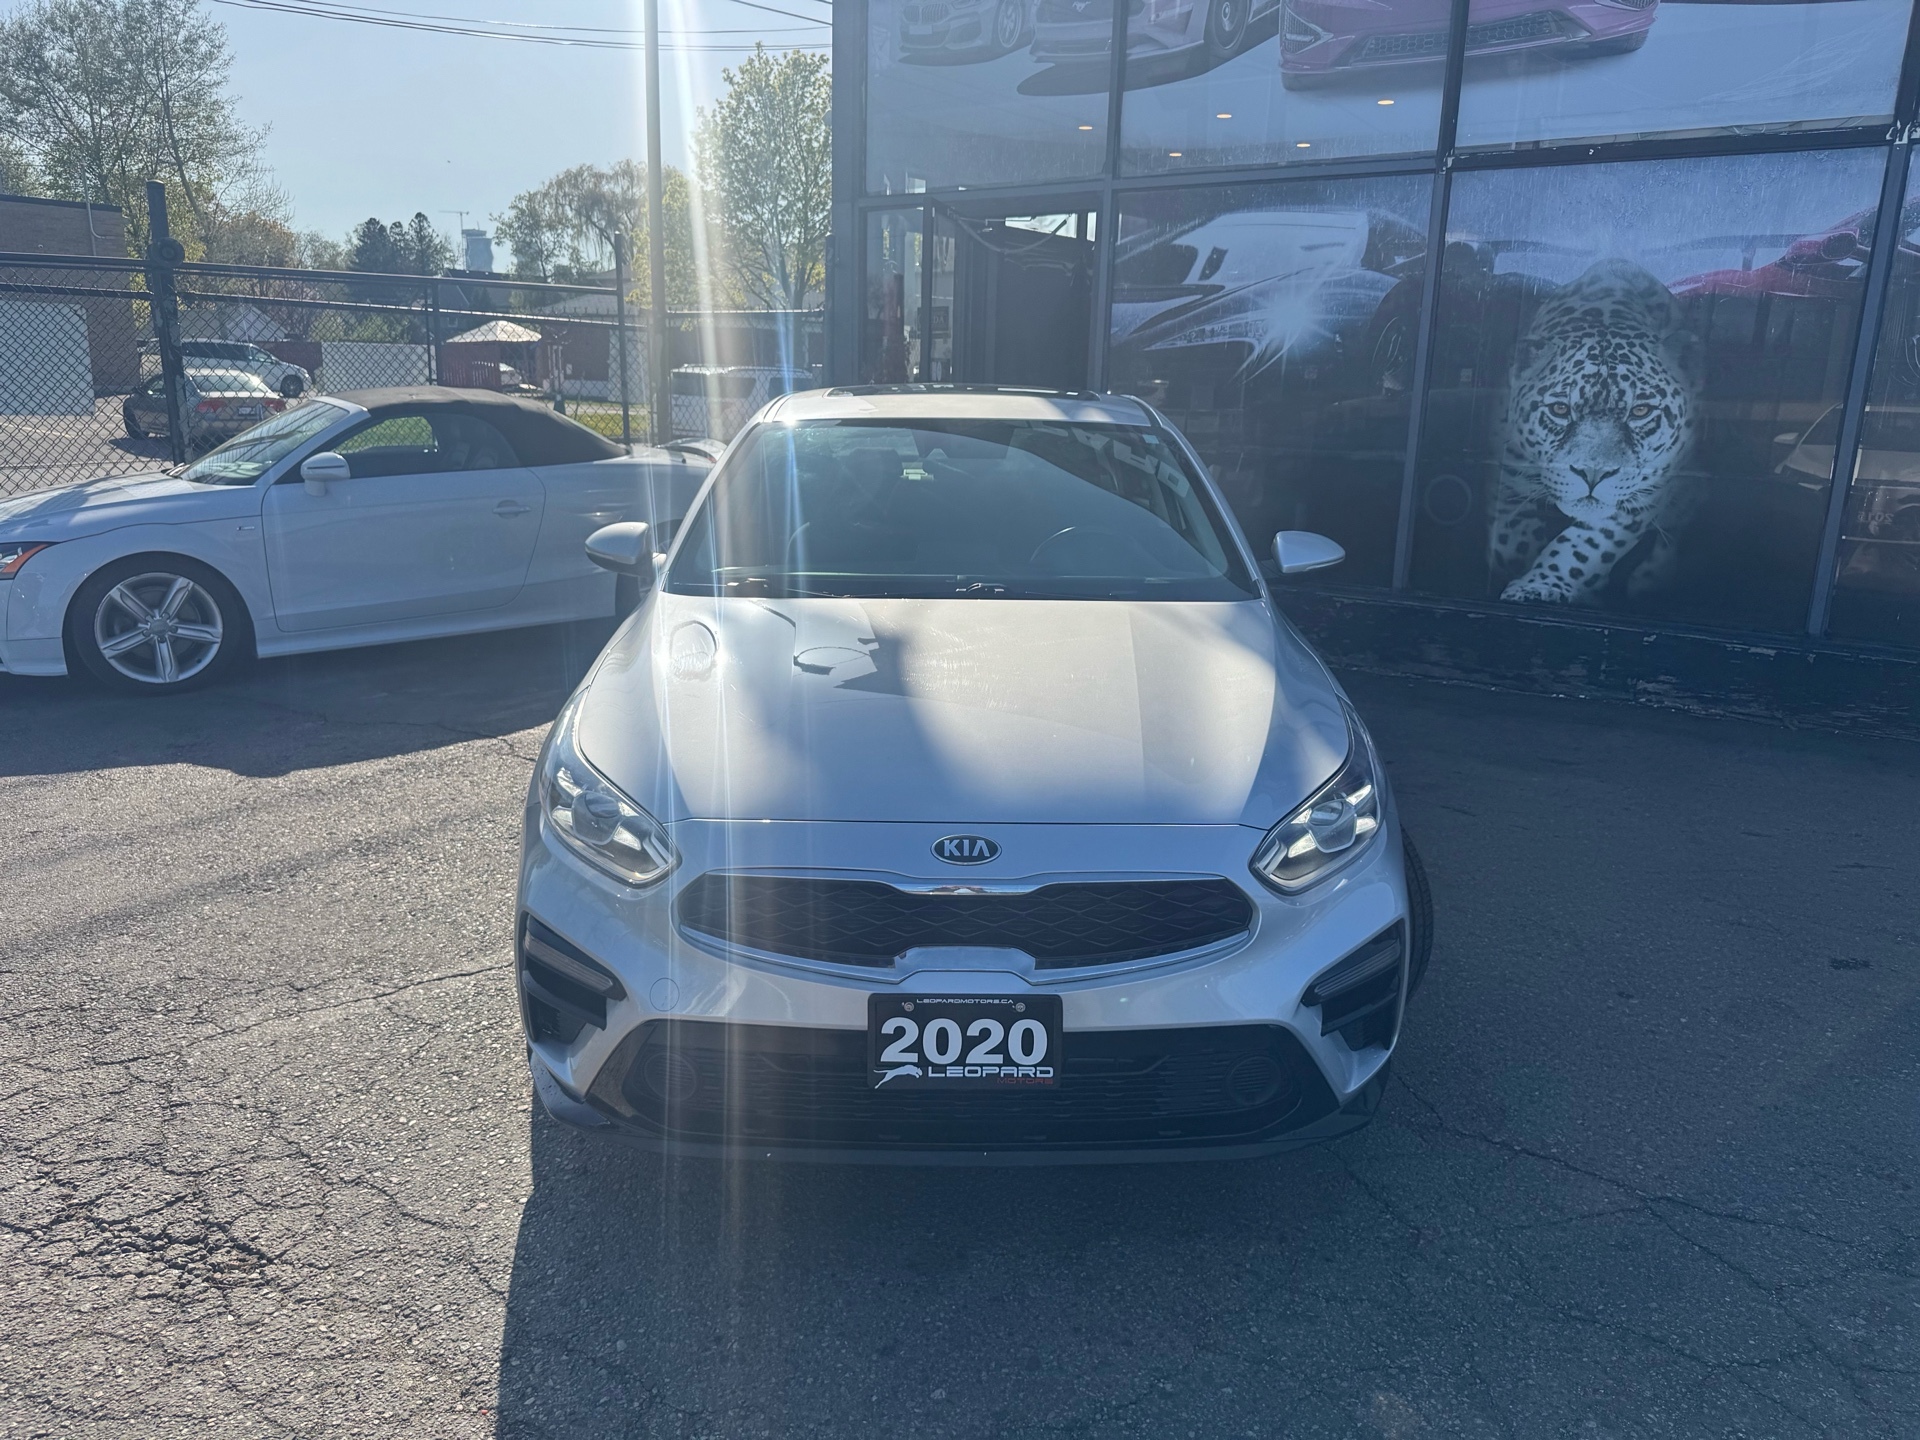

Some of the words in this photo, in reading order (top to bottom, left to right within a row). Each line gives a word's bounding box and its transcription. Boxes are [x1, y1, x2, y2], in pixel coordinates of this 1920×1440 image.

[943, 839, 990, 856] KIA
[880, 1017, 1047, 1065] 2020
[928, 1066, 1053, 1077] LEOPARD
